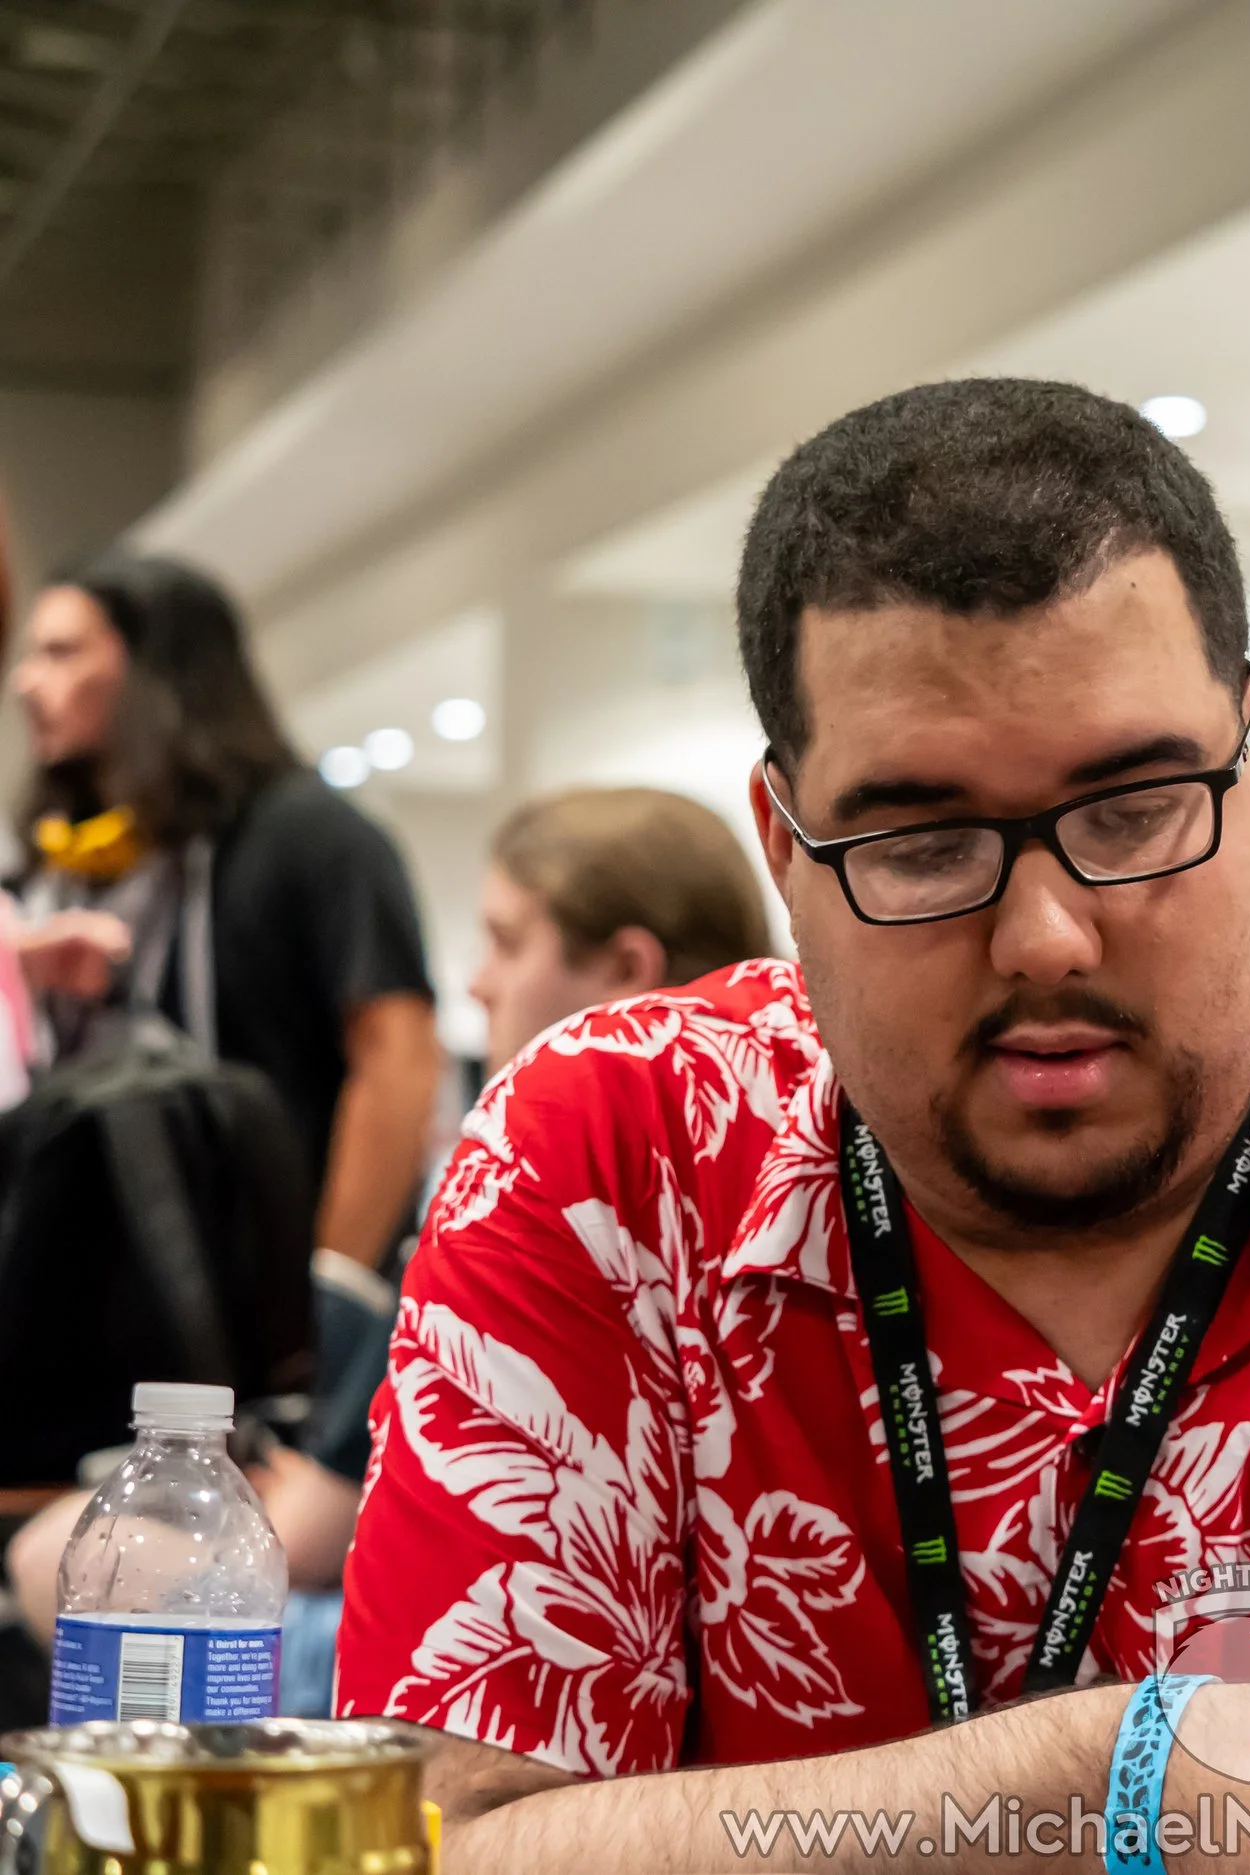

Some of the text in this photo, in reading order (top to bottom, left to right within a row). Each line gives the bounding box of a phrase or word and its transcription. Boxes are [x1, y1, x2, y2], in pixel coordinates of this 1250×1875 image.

[854, 1124, 892, 1238] MONSTER
[900, 1362, 934, 1484] MONSTER
[1125, 1313, 1187, 1427] MONSTER
[1039, 1550, 1094, 1668] MONSTER
[936, 1613, 968, 1721] MONSTE
